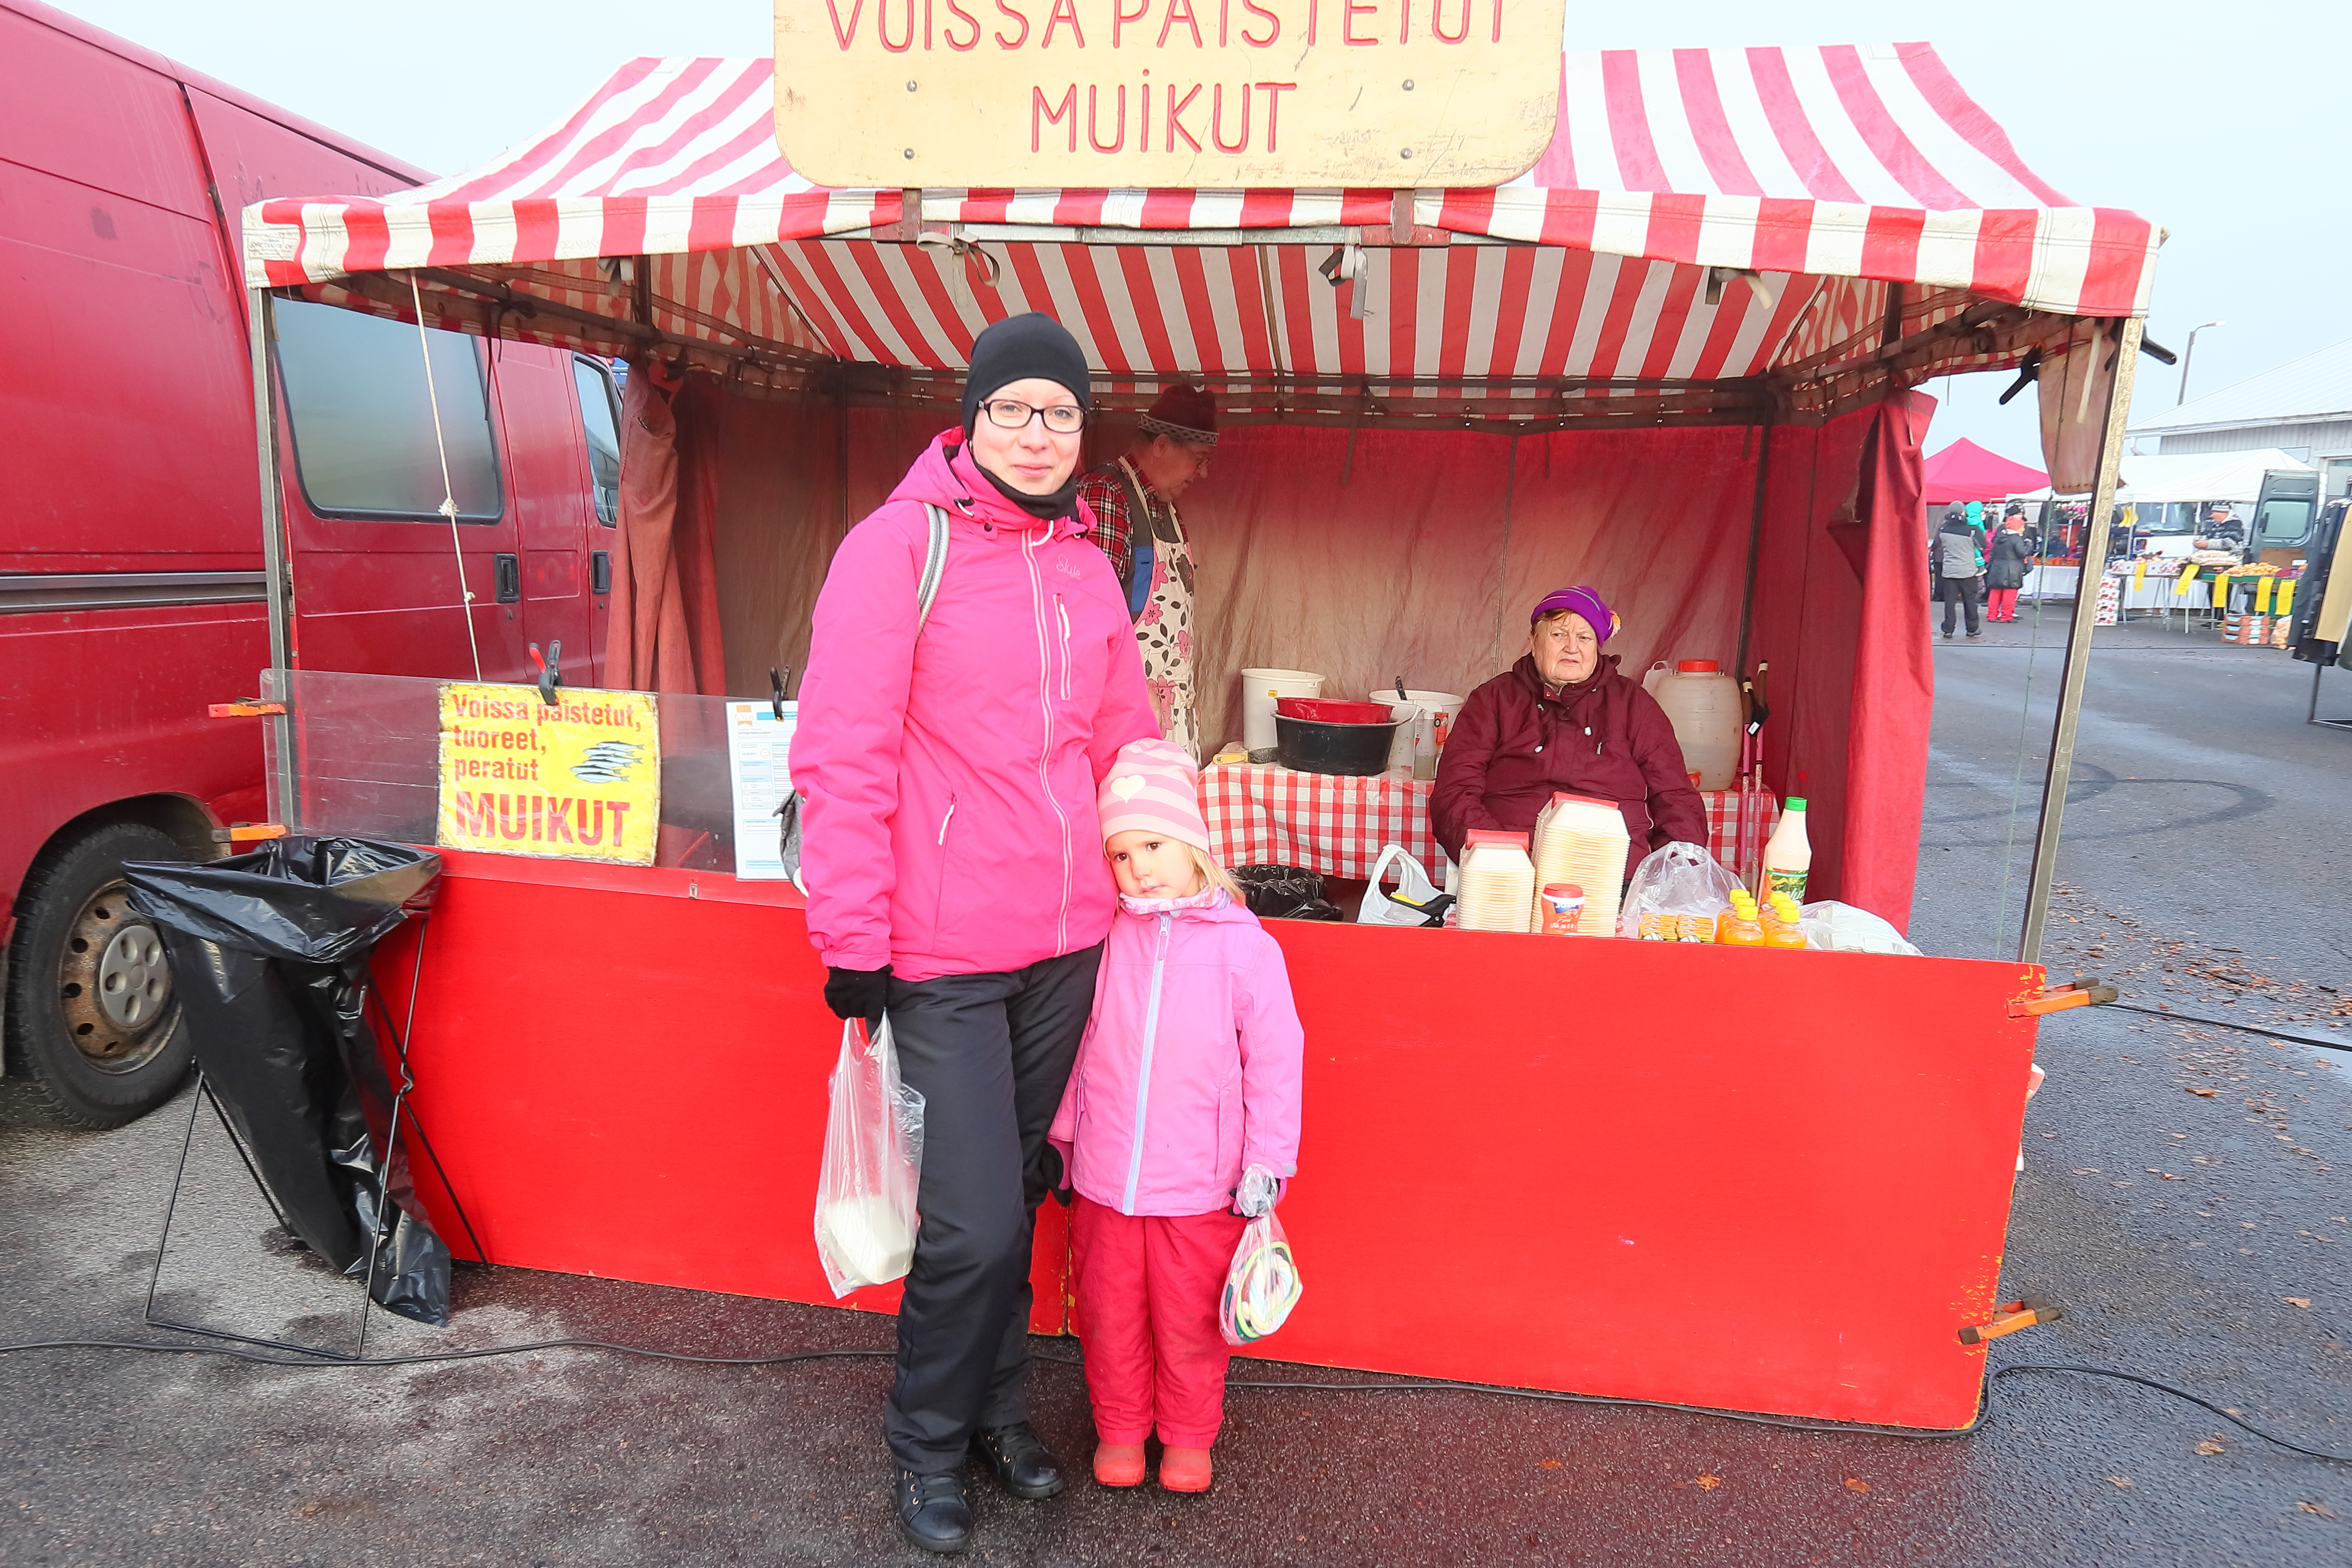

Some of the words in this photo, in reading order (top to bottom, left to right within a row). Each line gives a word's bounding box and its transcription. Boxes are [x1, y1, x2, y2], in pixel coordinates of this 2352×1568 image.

[452, 693, 528, 720] Voissa
[537, 698, 642, 732] paistetut,
[453, 725, 546, 755] tuoreet,
[454, 757, 539, 781] peratut
[456, 791, 630, 847] MUIKUT
